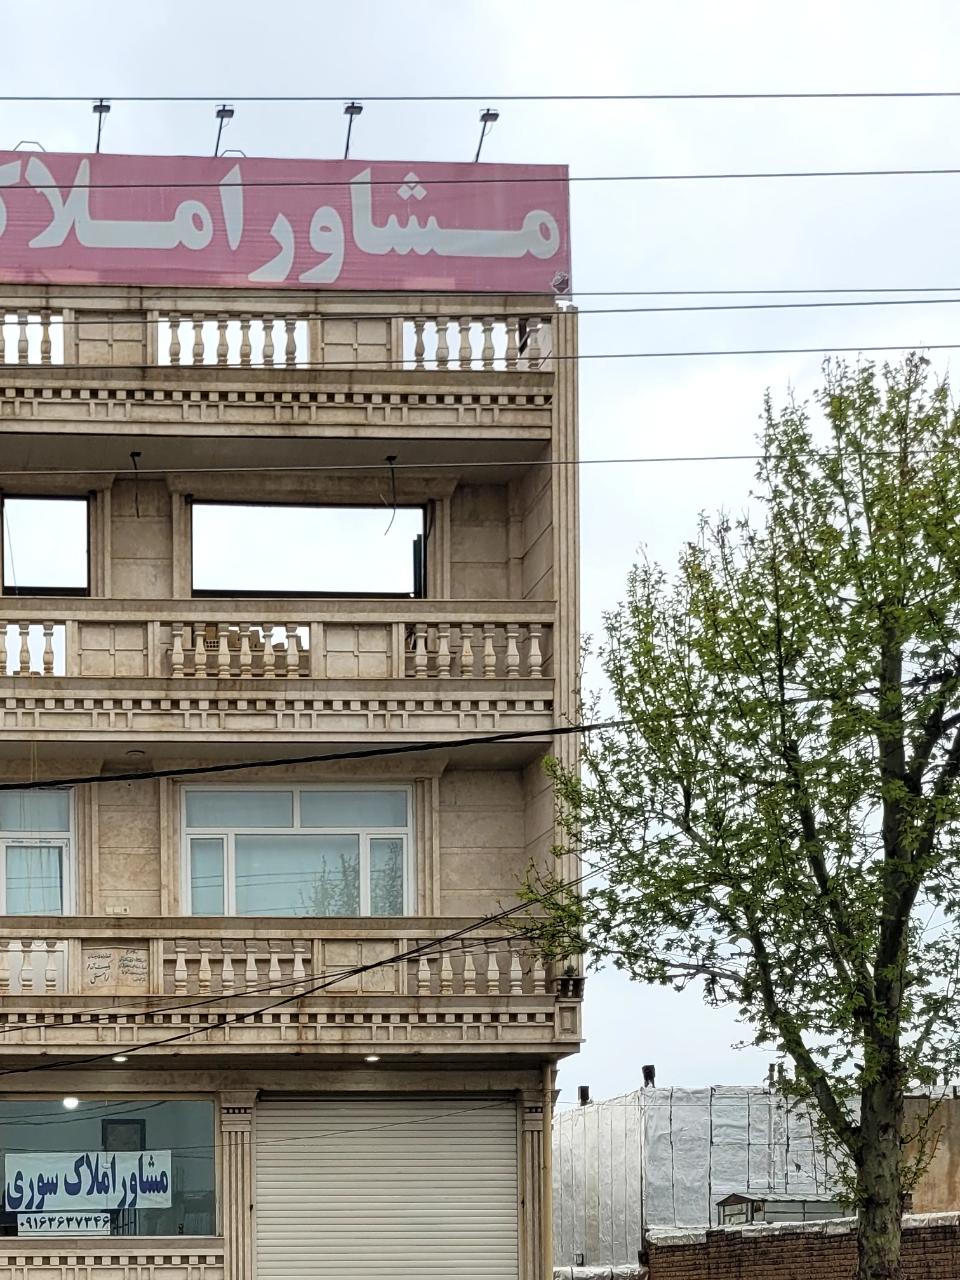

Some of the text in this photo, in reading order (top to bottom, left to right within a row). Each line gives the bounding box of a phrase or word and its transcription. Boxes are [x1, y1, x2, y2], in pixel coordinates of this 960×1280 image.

[247, 167, 560, 283] مشاور
[7, 1153, 169, 1210] مشاور املاک سوری
[19, 1215, 110, 1230] ۰۹۱۶۳۶۳۷۳۴۶
